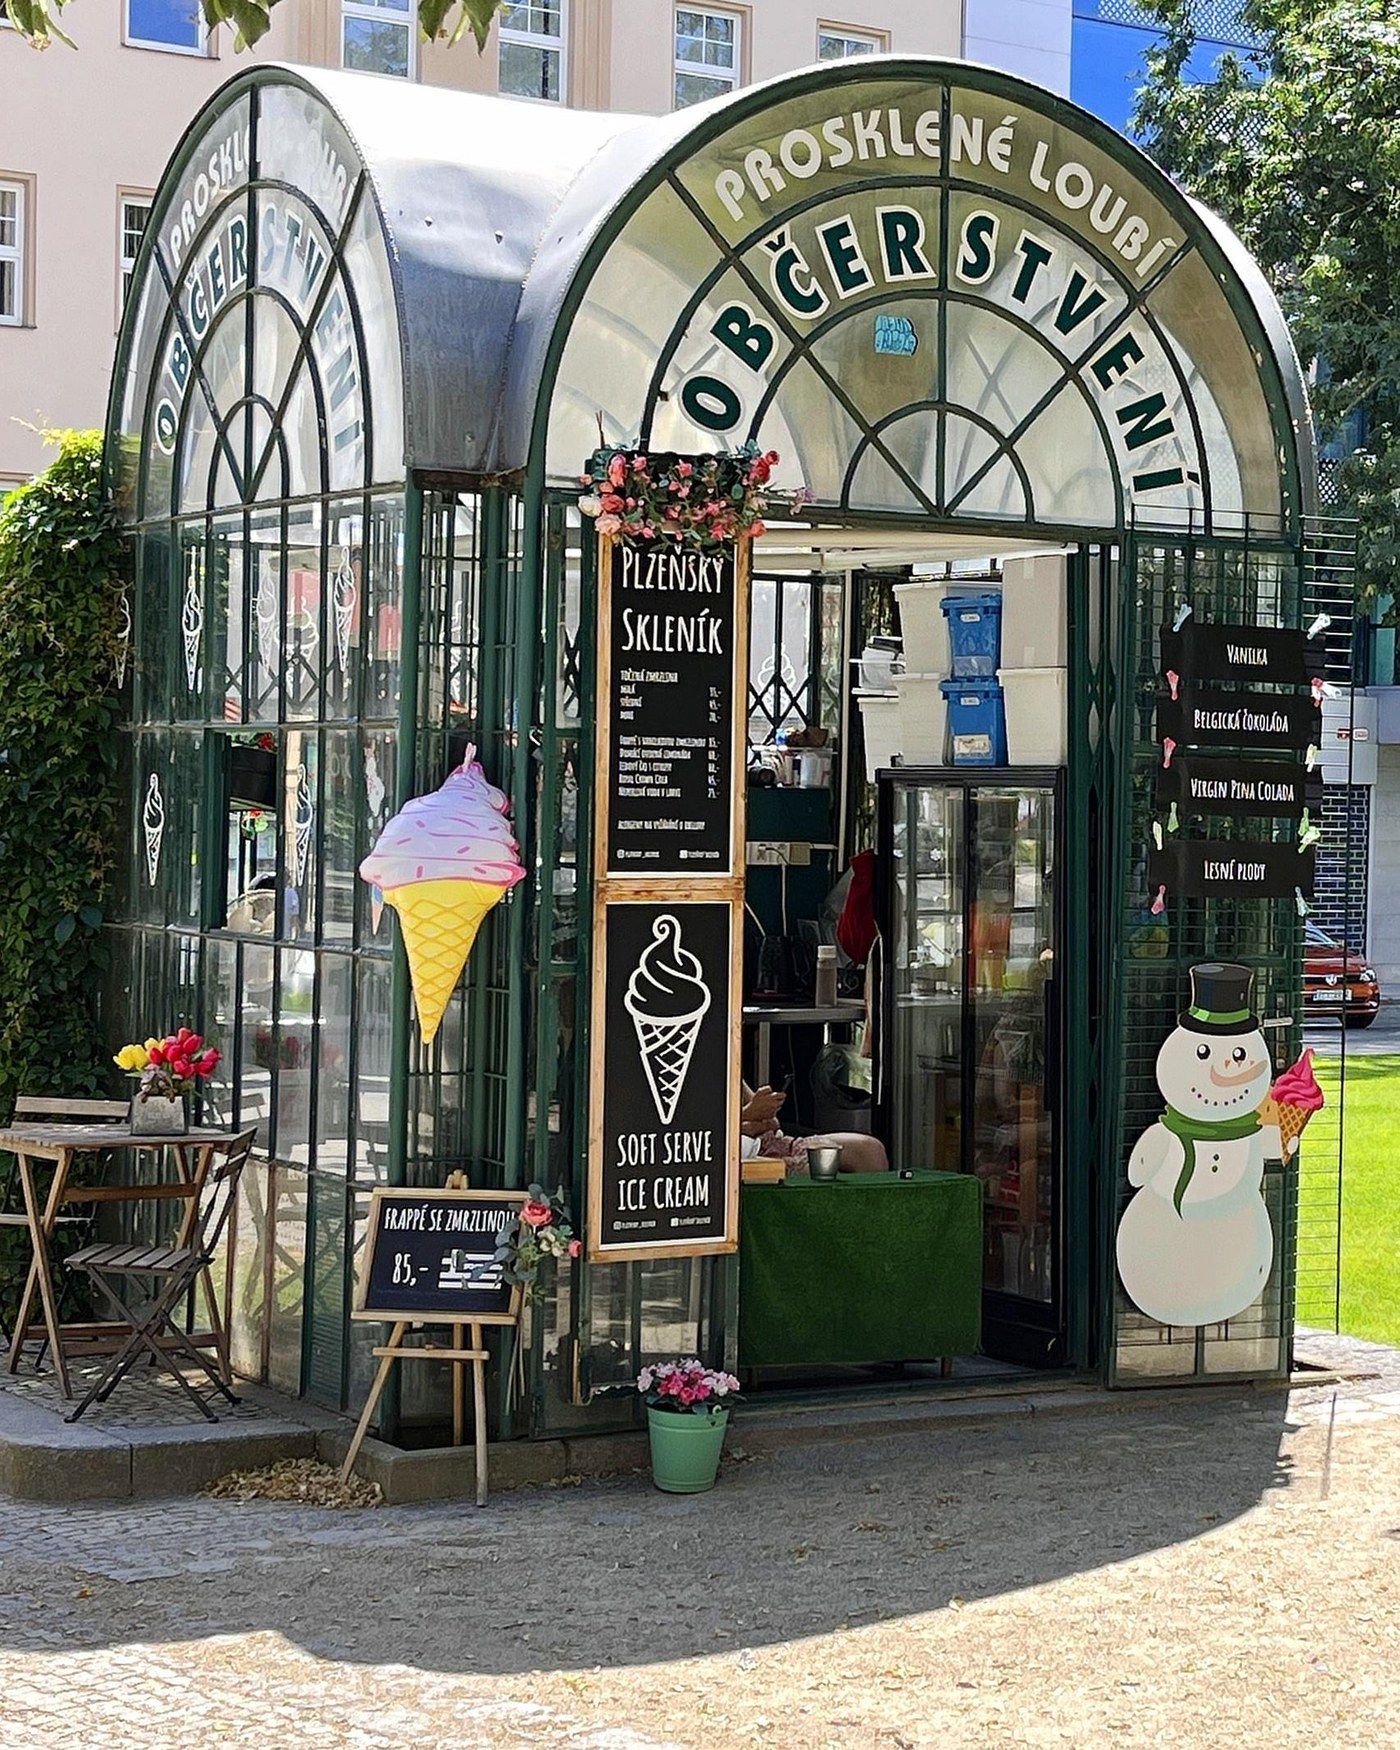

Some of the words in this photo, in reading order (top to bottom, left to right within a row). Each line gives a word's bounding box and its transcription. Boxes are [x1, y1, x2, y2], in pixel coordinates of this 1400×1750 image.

[714, 109, 1014, 222] PROSKLENÉ
[1029, 139, 1177, 277] LOUBÍ
[678, 206, 1202, 493] OBČERSTVENÍ
[621, 607, 723, 655] SKLENÍK
[617, 1133, 657, 1167] SOFT
[663, 1130, 712, 1164] SERVE
[617, 1178, 648, 1211] ICE
[653, 1174, 709, 1209] CREAM
[384, 1204, 429, 1231] FRAPPÉ
[428, 1209, 442, 1231] SE
[392, 1253, 430, 1286] 85,-
